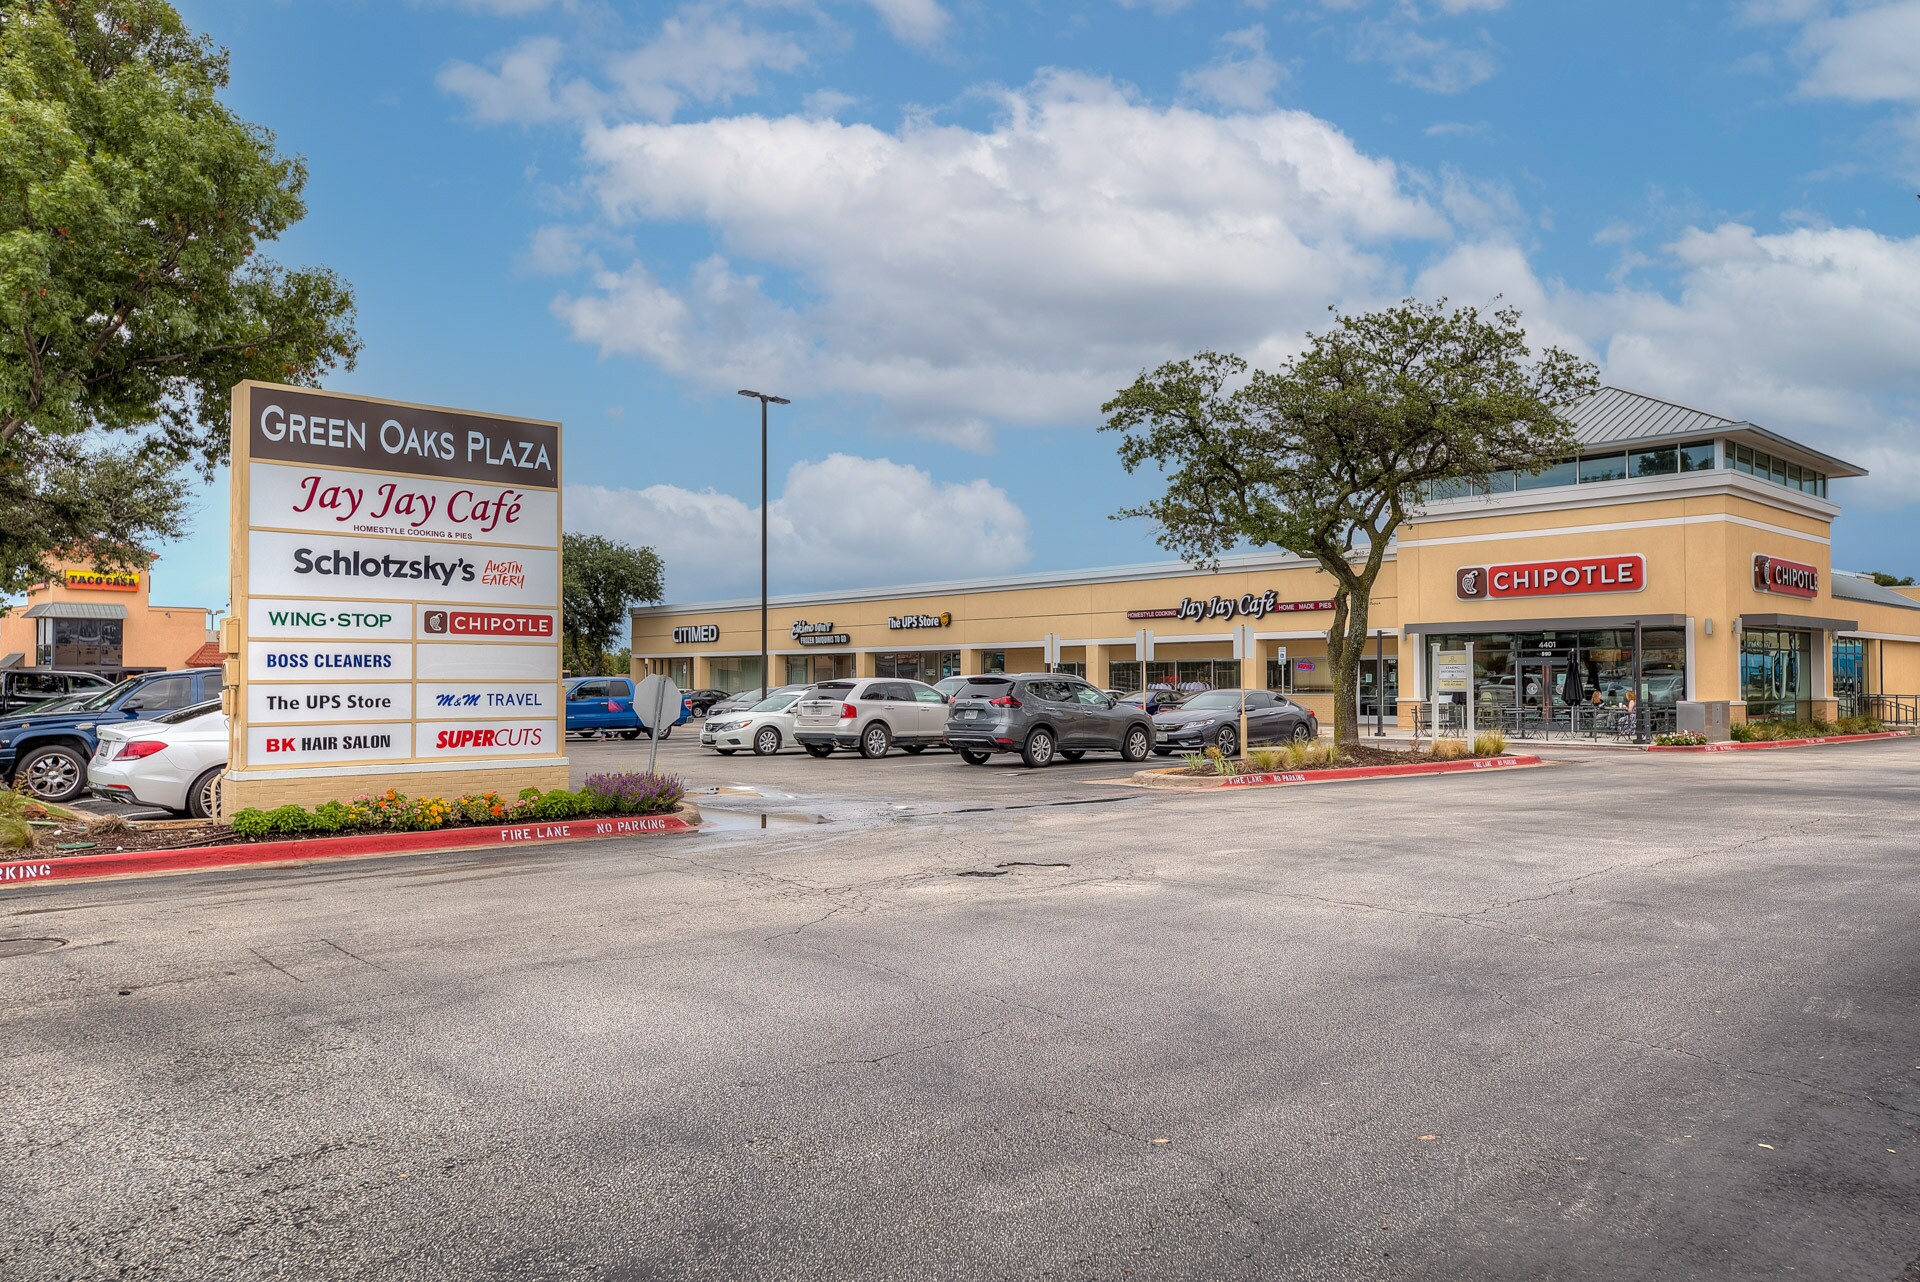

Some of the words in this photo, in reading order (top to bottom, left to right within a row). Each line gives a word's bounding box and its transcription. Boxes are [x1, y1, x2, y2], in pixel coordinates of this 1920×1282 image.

[261, 405, 366, 451] GREEN
[380, 420, 455, 461] OAKS
[468, 431, 552, 470] PLAZA
[292, 476, 363, 522] Jay
[370, 484, 436, 527] Jay
[446, 490, 524, 532] Café
[353, 525, 404, 536] HOMESTYLE
[408, 528, 445, 538] COOKING
[294, 548, 475, 586] Schlotzsky's
[484, 560, 522, 574] AUSTIN
[70, 575, 102, 585] TACO
[106, 576, 136, 586] CASA
[482, 573, 525, 588] EATERY
[1493, 563, 1634, 590] CHIPOTLE
[1775, 565, 1818, 590] CHIPOTLE
[1178, 598, 1204, 621] Jay
[1206, 596, 1234, 620] Jay
[1239, 590, 1276, 619] Café
[454, 616, 549, 632] CHIPOTLE
[888, 617, 901, 628] The
[902, 616, 918, 628] UPS
[918, 616, 940, 627] Store
[673, 626, 717, 643] CITIMED
[267, 654, 308, 668] BOSS
[314, 654, 391, 667] CLEANERS
[267, 696, 300, 710] The
[306, 695, 341, 709] UPS
[347, 694, 391, 708] Store
[436, 694, 480, 706] M&M
[487, 693, 542, 706] TRAVEL
[266, 738, 296, 752] BK
[302, 736, 338, 751] HAIR
[342, 734, 391, 750] SALON
[436, 728, 542, 748] SUPERCUTS
[1228, 776, 1245, 784] FIRE
[502, 828, 531, 841] FIRE
[536, 826, 570, 839] LANE
[596, 823, 612, 834] NO
[618, 820, 665, 831] PARKING
